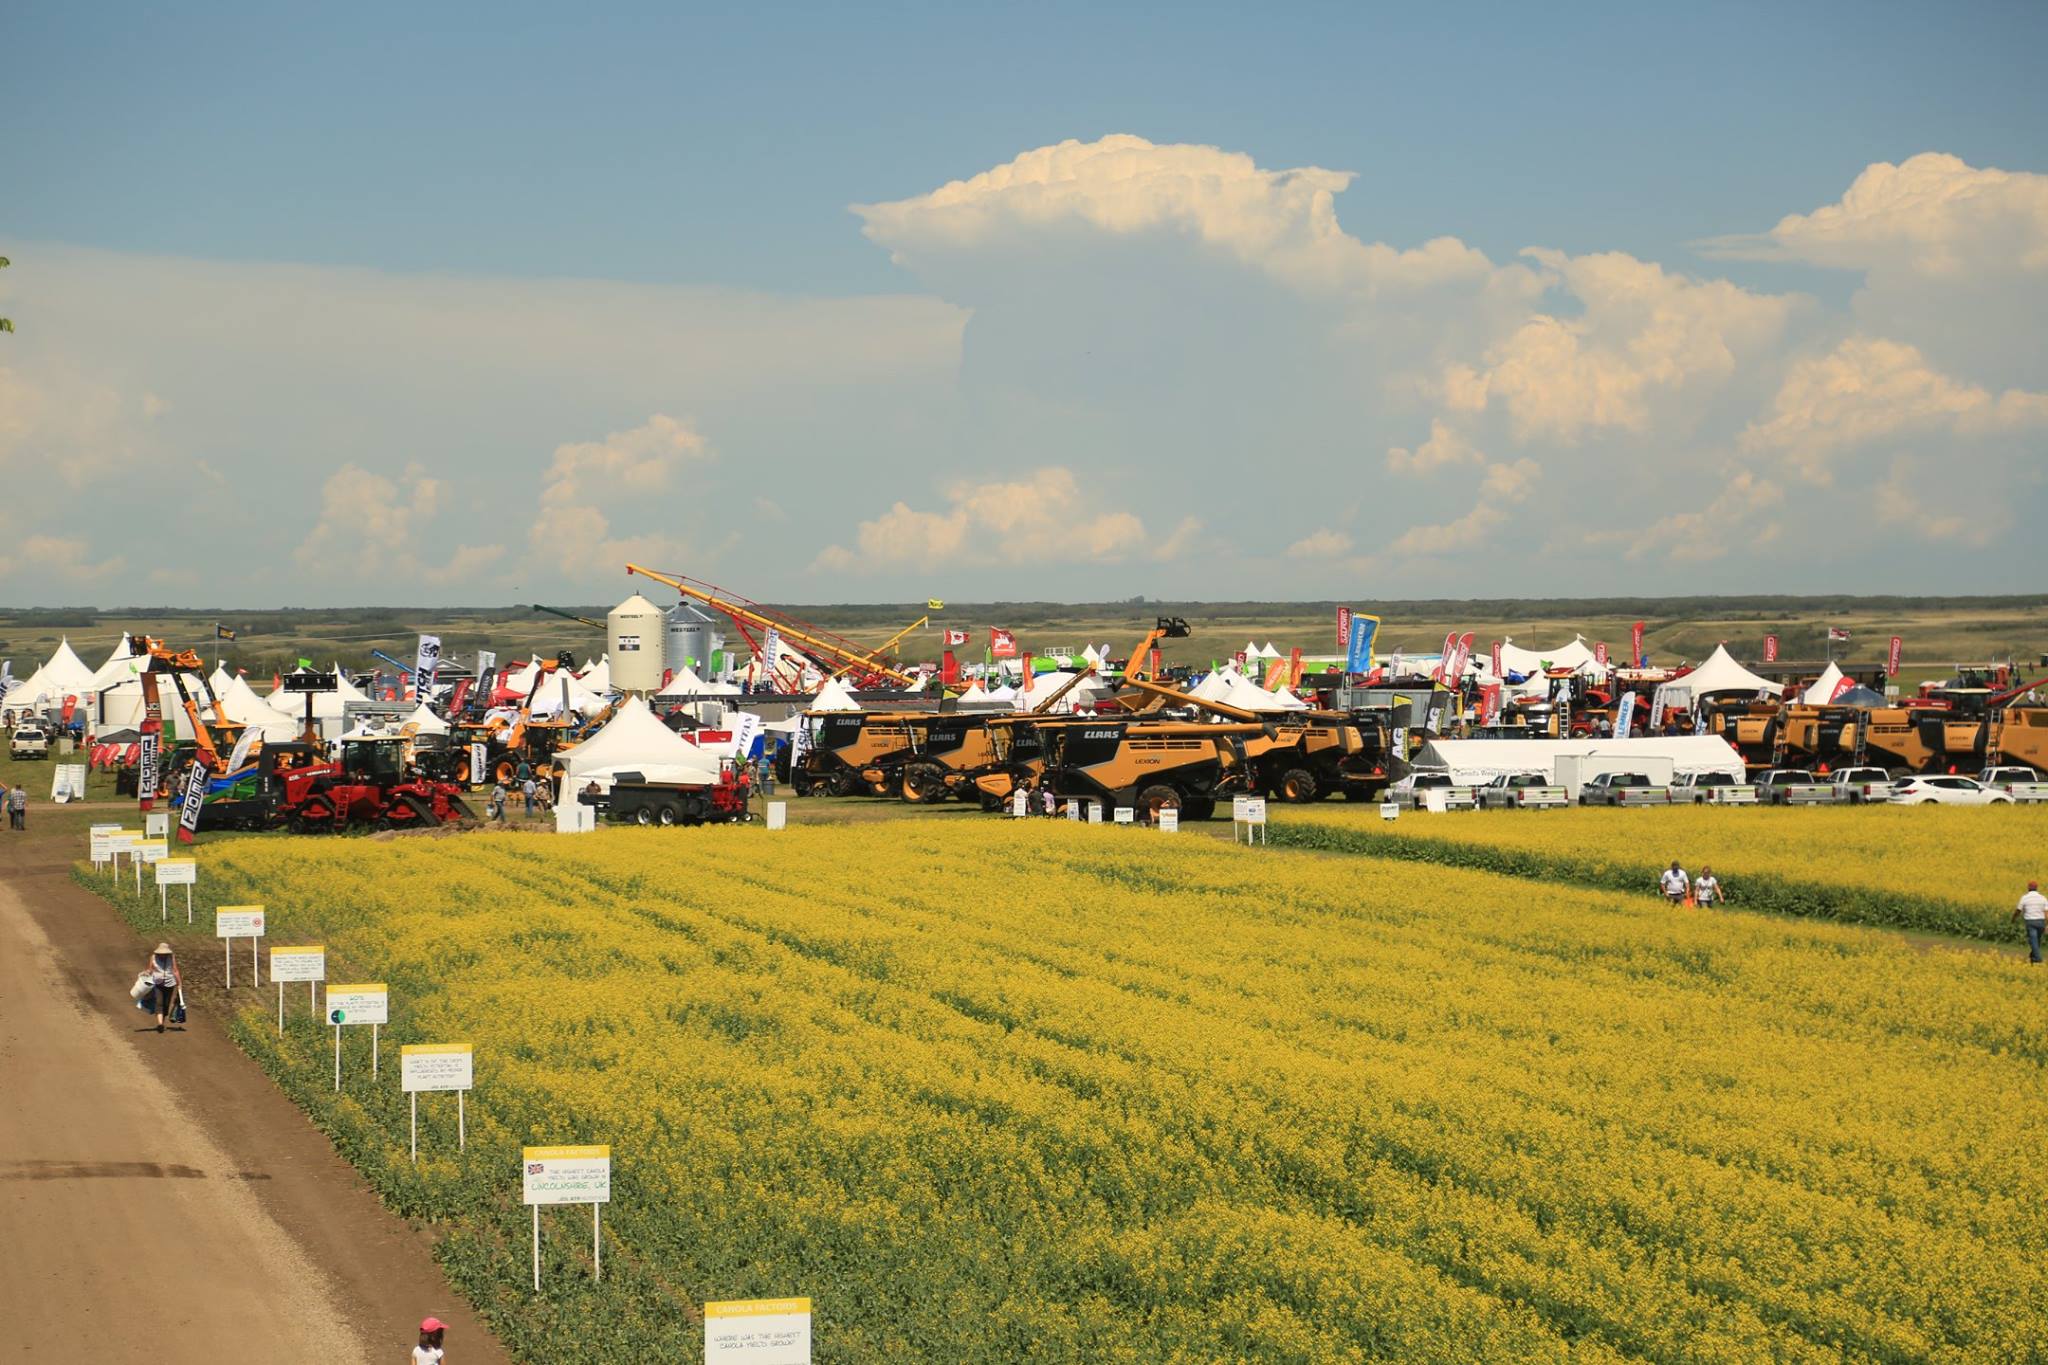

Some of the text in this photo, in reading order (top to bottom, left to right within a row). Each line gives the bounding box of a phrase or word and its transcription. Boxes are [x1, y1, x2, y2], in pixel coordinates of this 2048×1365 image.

[1427, 707, 1441, 734] AG
[1617, 701, 1629, 735] LEMKEN
[1084, 731, 1120, 739] CLAAS
[1392, 728, 1404, 761] AG
